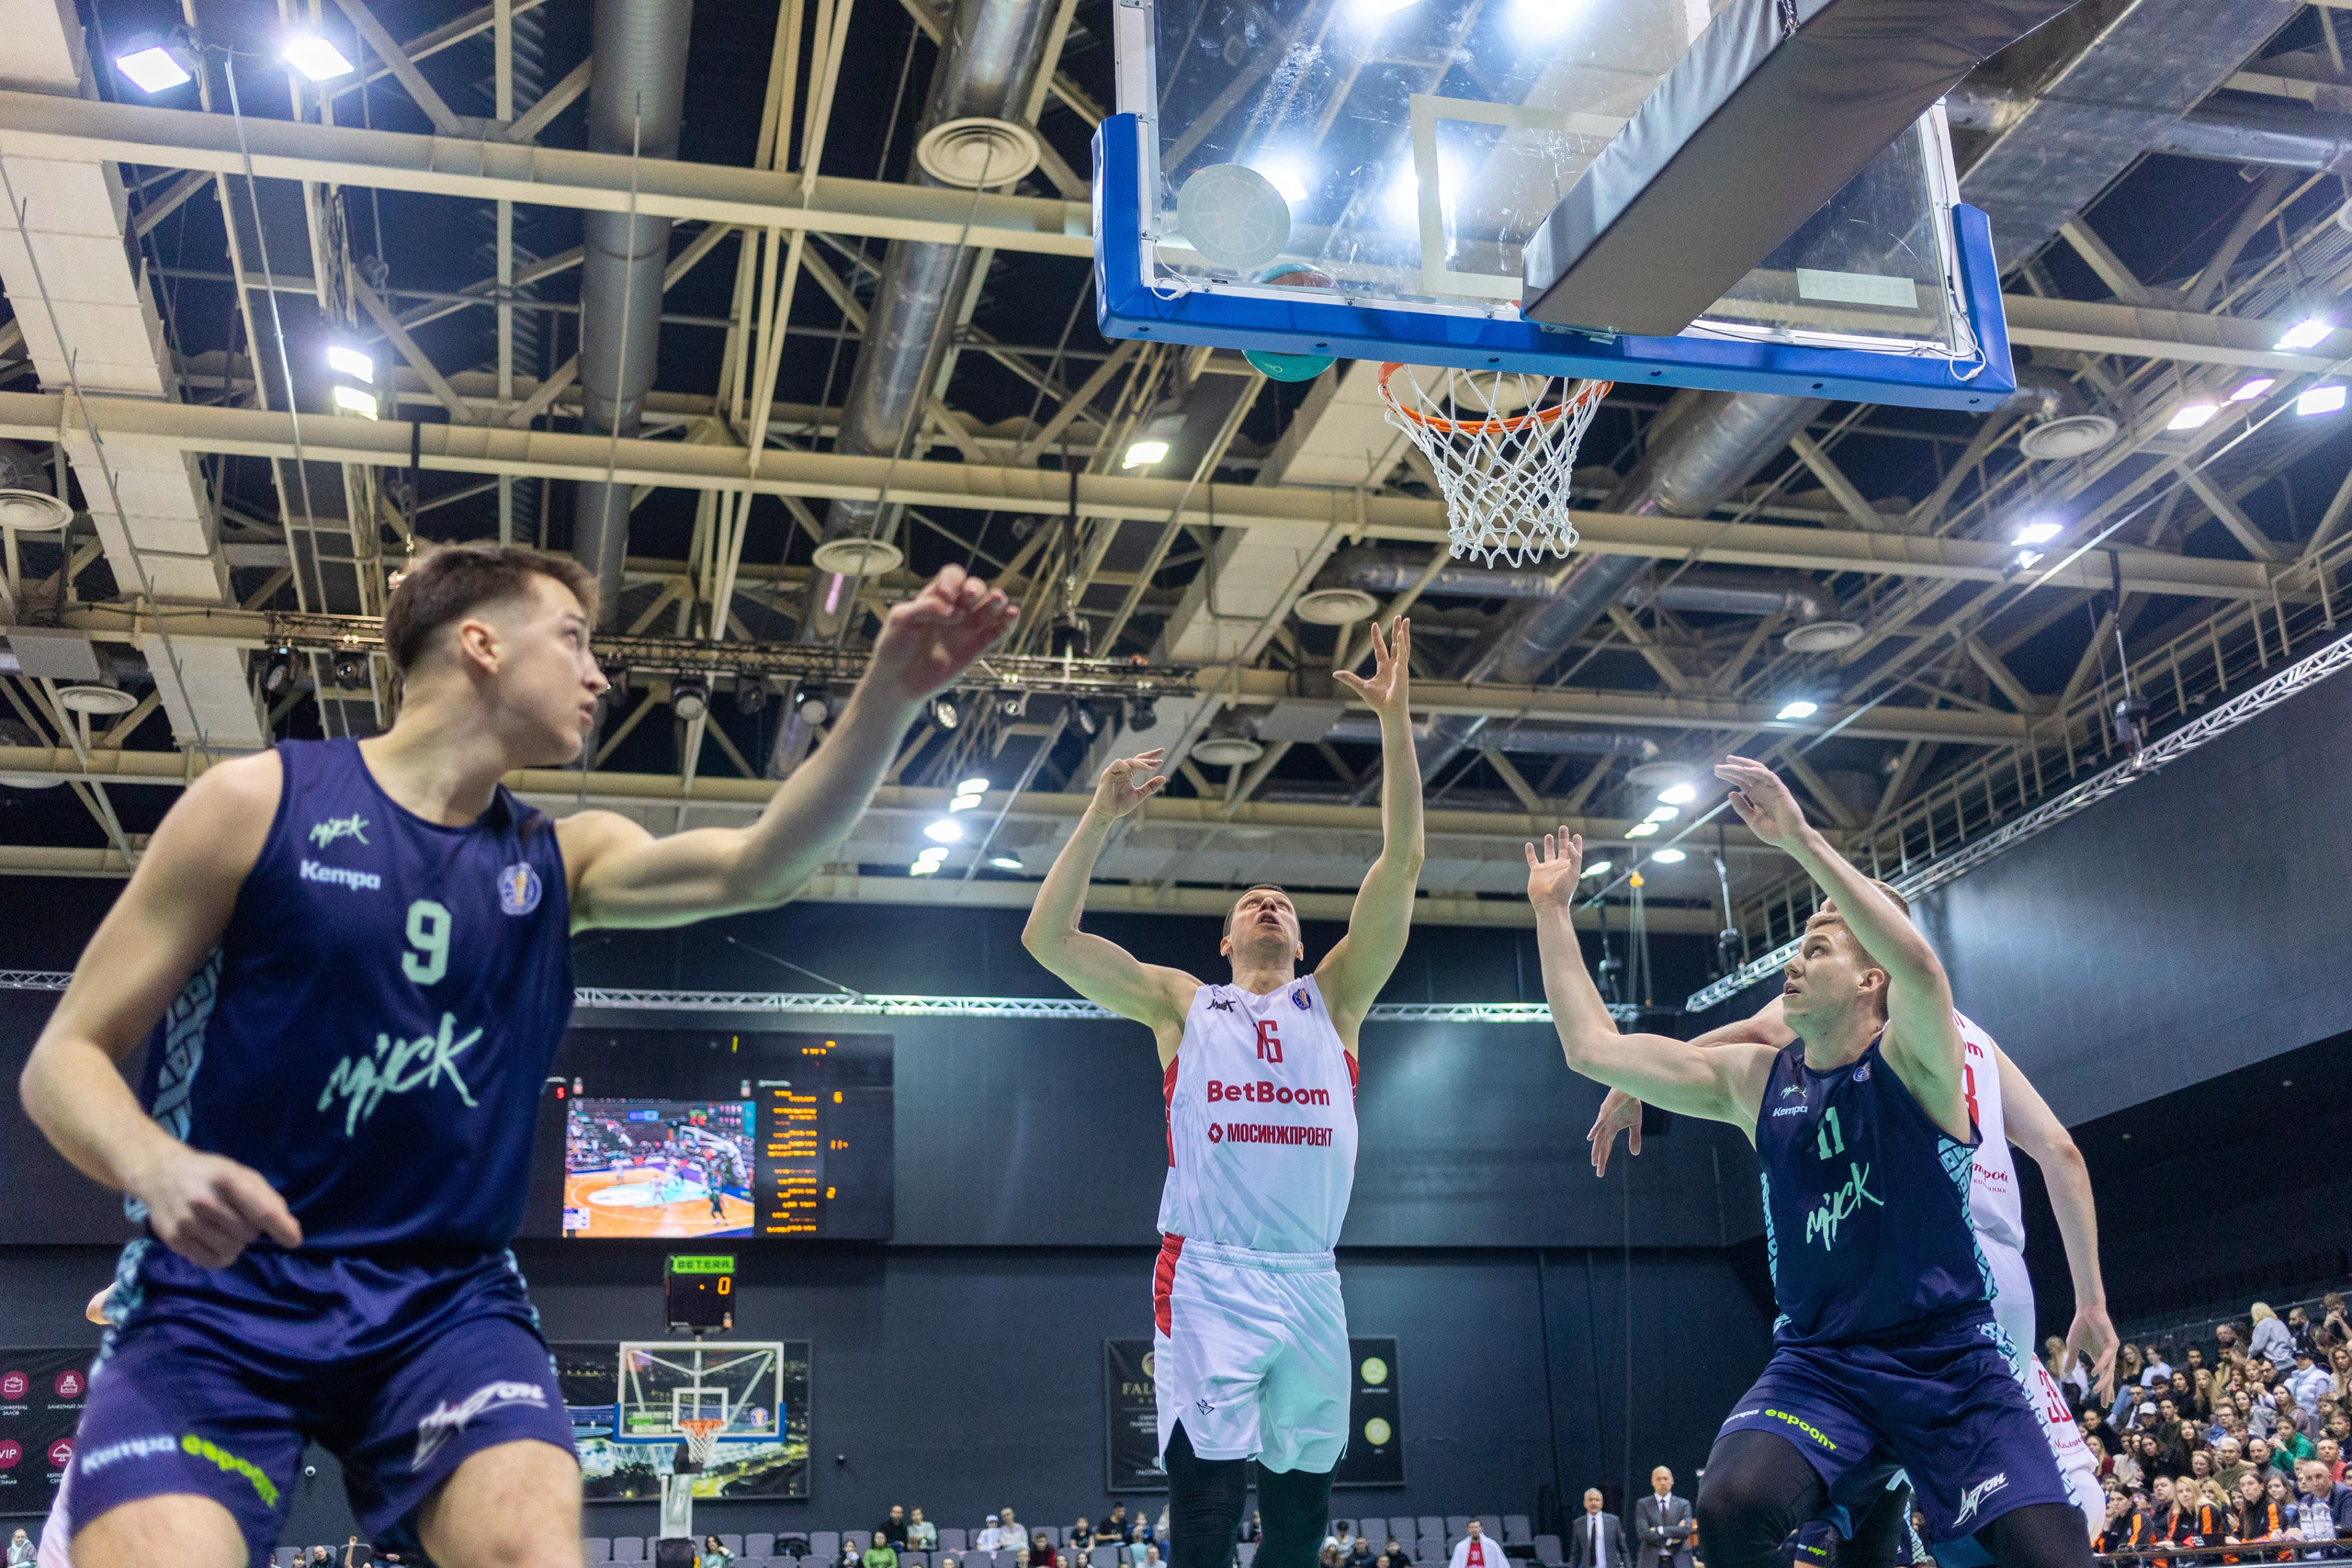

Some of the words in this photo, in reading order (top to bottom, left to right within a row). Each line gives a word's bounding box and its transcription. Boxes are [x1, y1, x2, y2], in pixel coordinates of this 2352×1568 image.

[300, 860, 381, 891] Kempa
[401, 899, 452, 985] 9
[1253, 1020, 1283, 1064] 16
[1207, 1079, 1330, 1106] BetBoom
[1772, 1105, 1808, 1117] Kempa
[1227, 1122, 1333, 1147] МОСИНЖПРОЕКТ
[1817, 1106, 1845, 1160] 11
[678, 1259, 729, 1269] BETERA
[718, 1276, 731, 1295] 0
